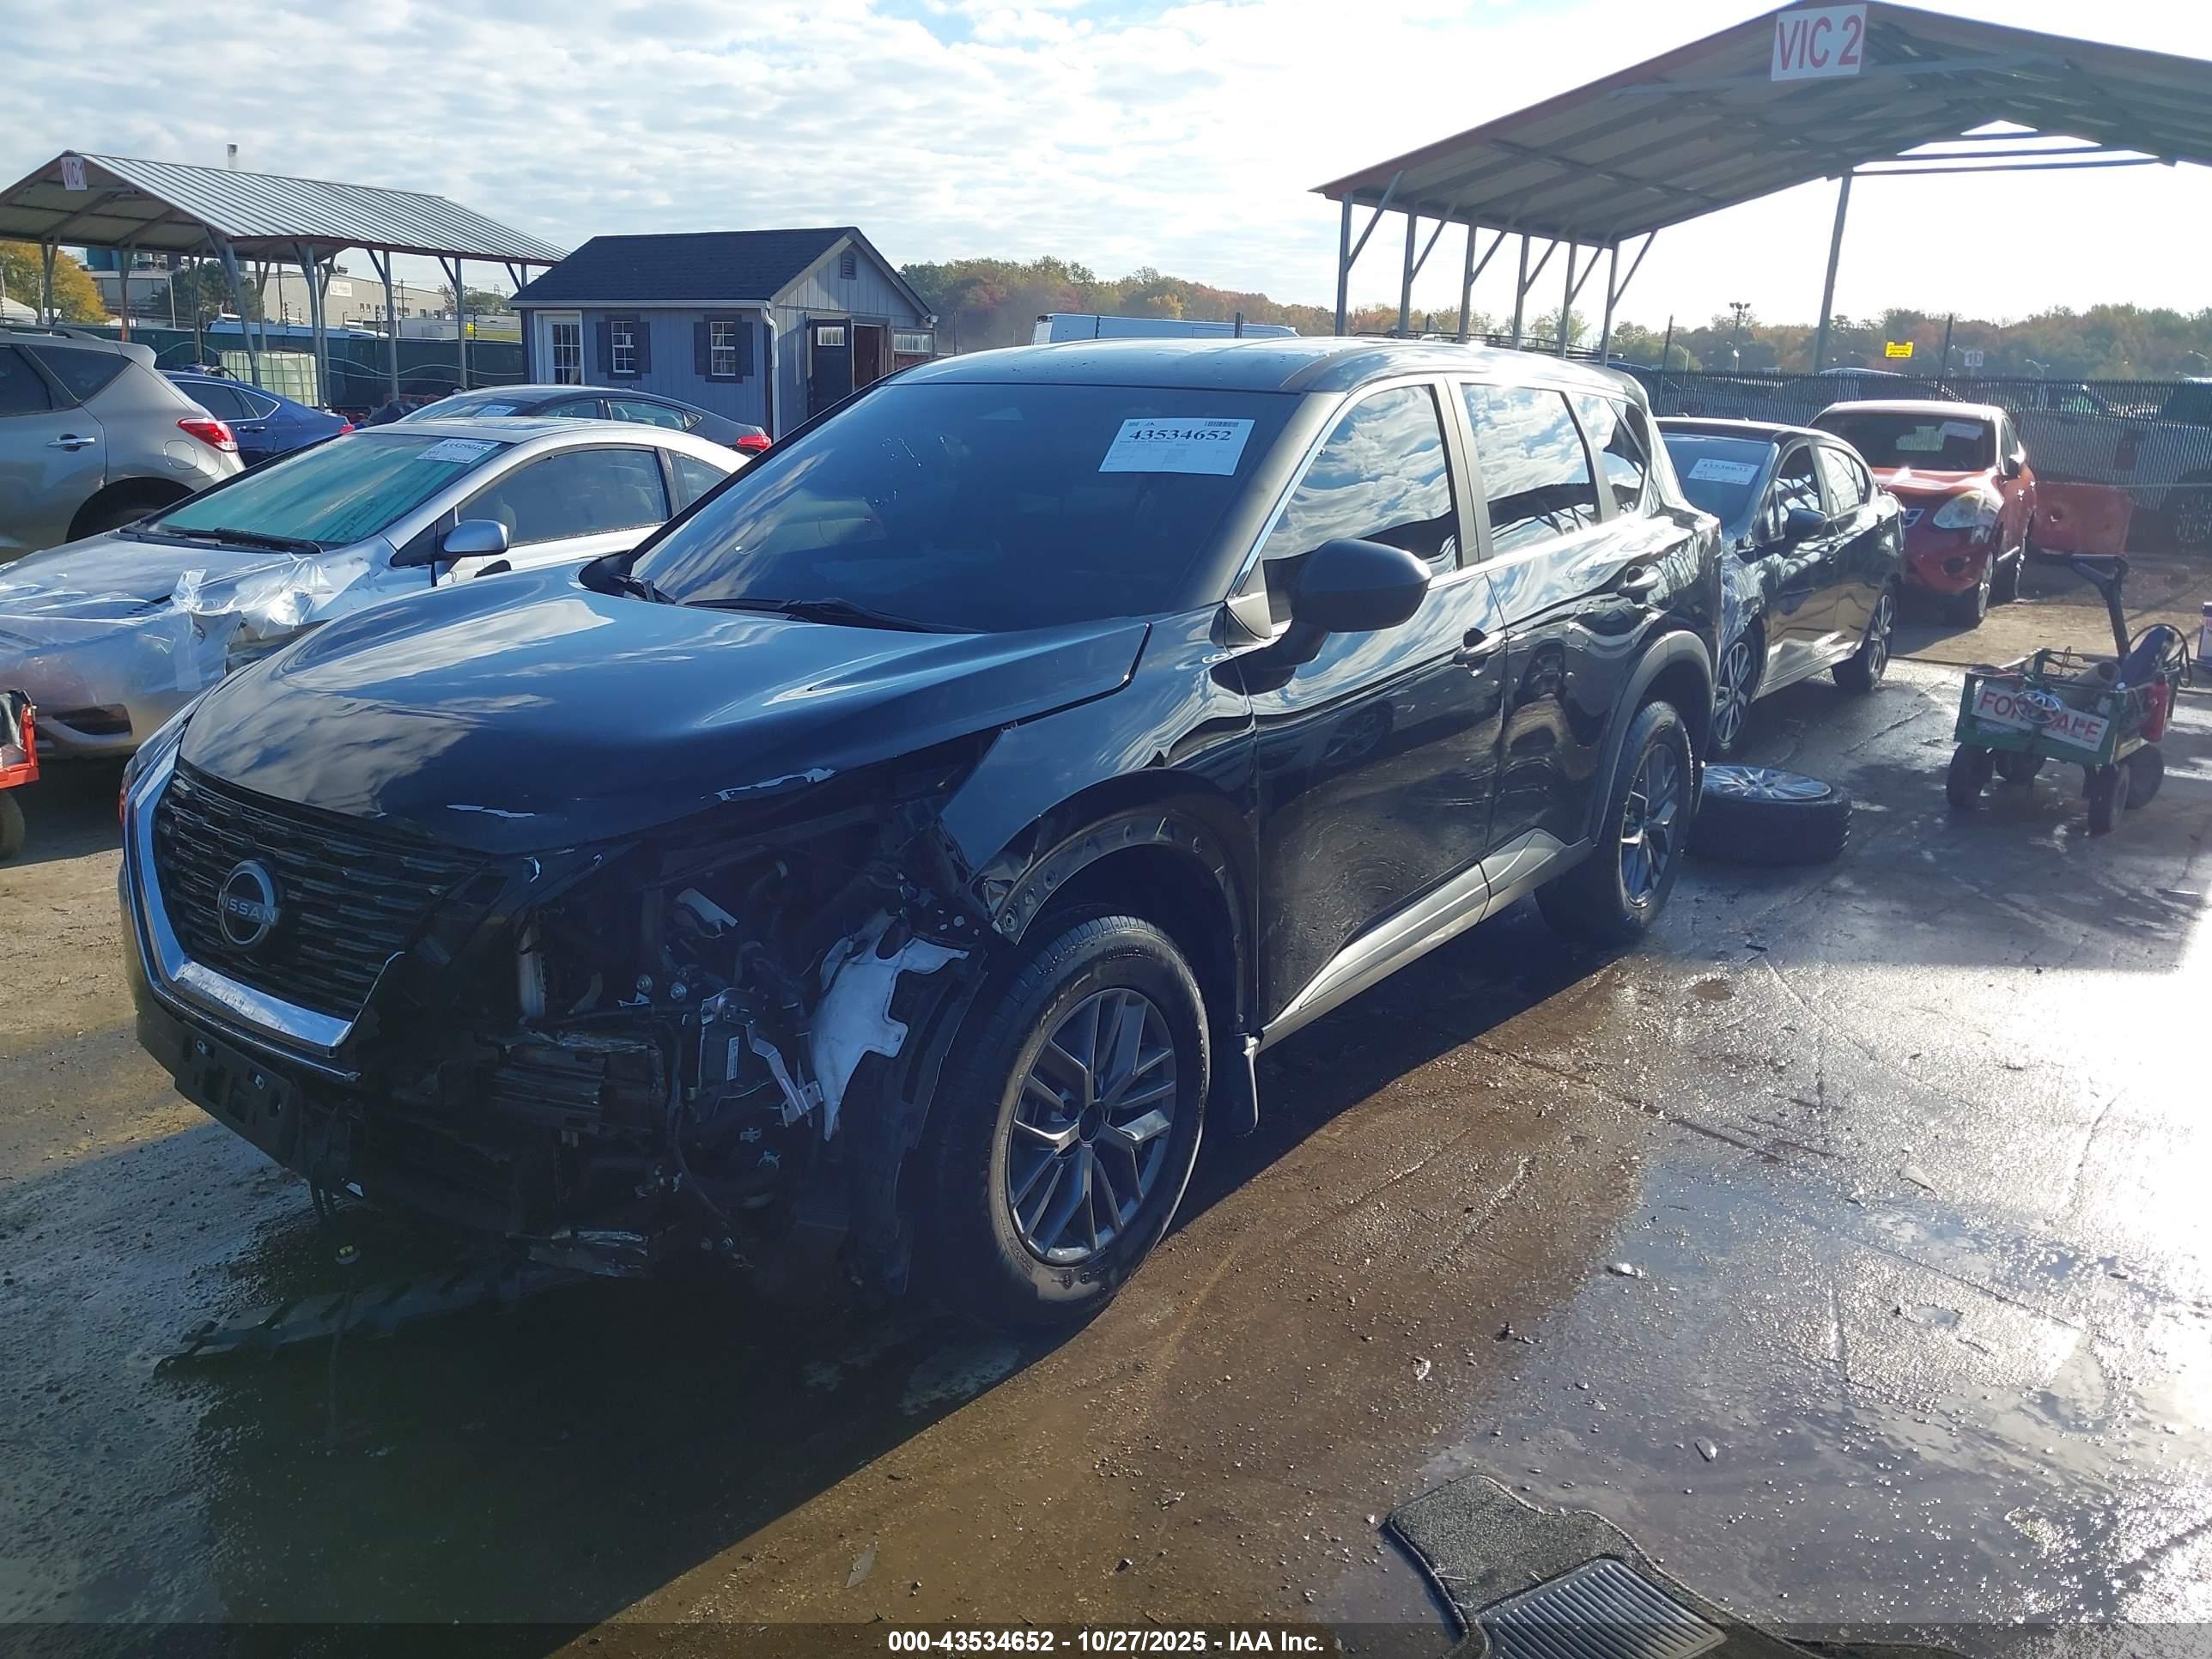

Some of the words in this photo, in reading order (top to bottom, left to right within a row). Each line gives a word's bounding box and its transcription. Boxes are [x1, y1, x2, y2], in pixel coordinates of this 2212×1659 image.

[1778, 16, 1832, 70] VIC
[1838, 15, 1862, 65] 2
[62, 161, 80, 186] VIC
[1128, 429, 1231, 441] 43534652
[1978, 690, 2035, 721] FOR
[217, 888, 276, 923] NISSAN
